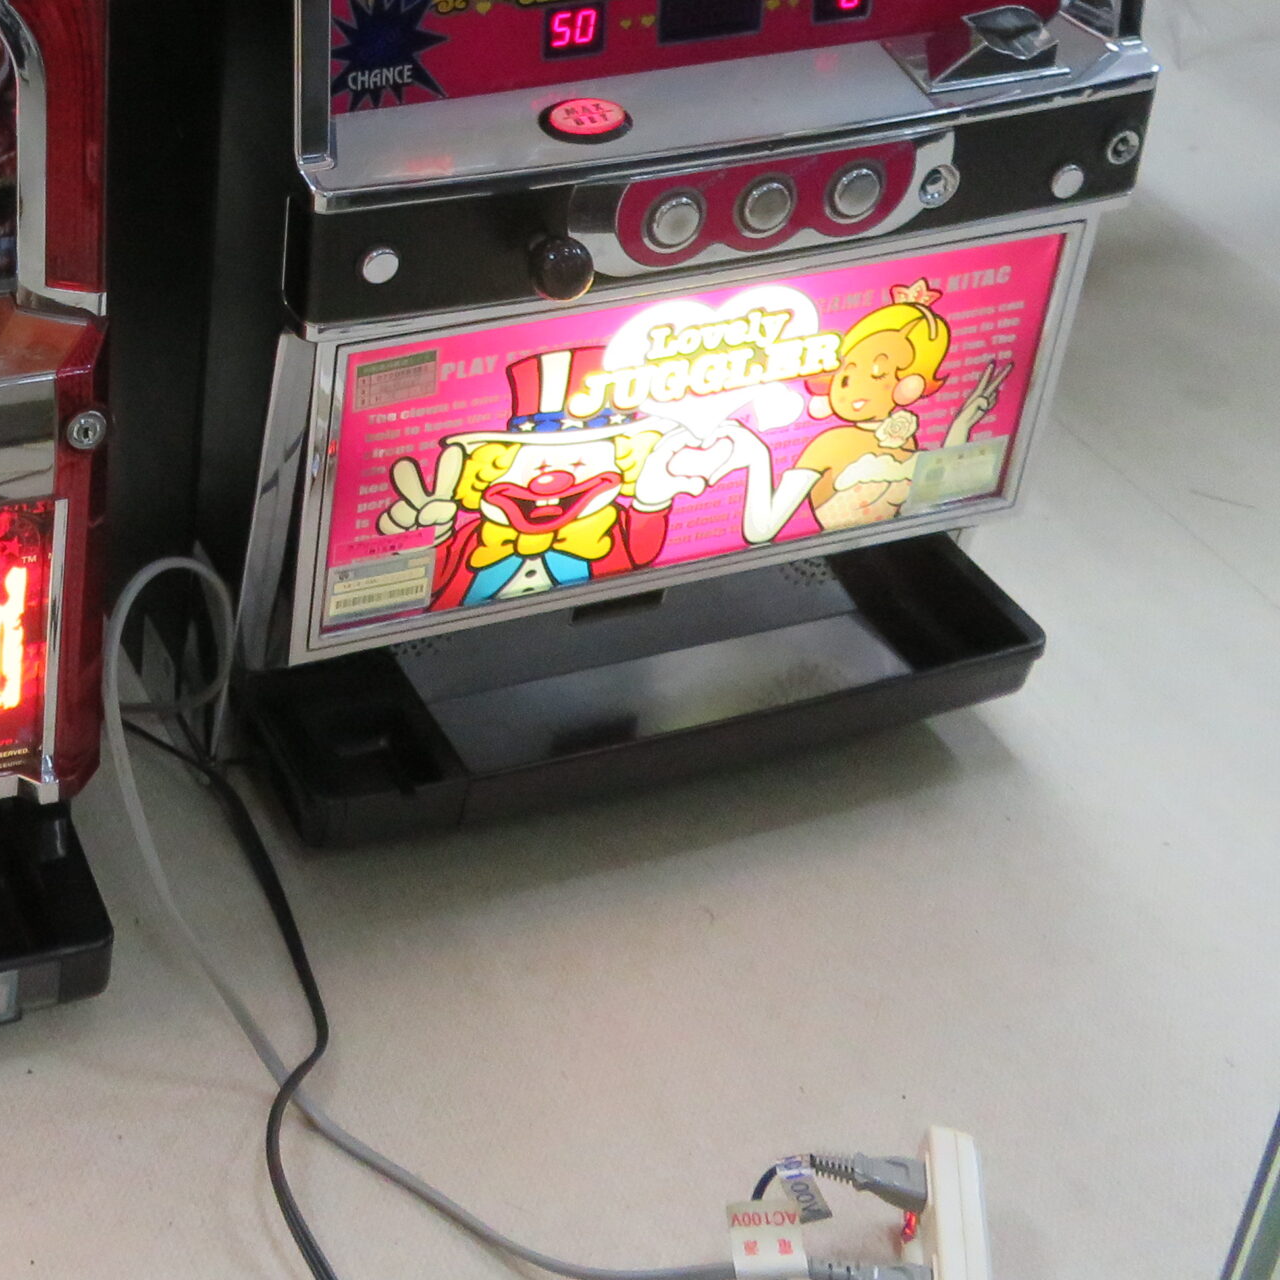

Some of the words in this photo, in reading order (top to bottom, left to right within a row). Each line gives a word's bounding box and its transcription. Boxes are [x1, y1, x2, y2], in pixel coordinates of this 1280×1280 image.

[551, 9, 597, 48] 50
[347, 65, 413, 91] CHANCE
[564, 103, 604, 116] MAX
[946, 265, 1012, 293] KITAC
[647, 307, 793, 361] Lovely
[439, 355, 498, 382] PLAY
[21, 554, 37, 564] TM
[731, 1210, 797, 1228] AC100V
